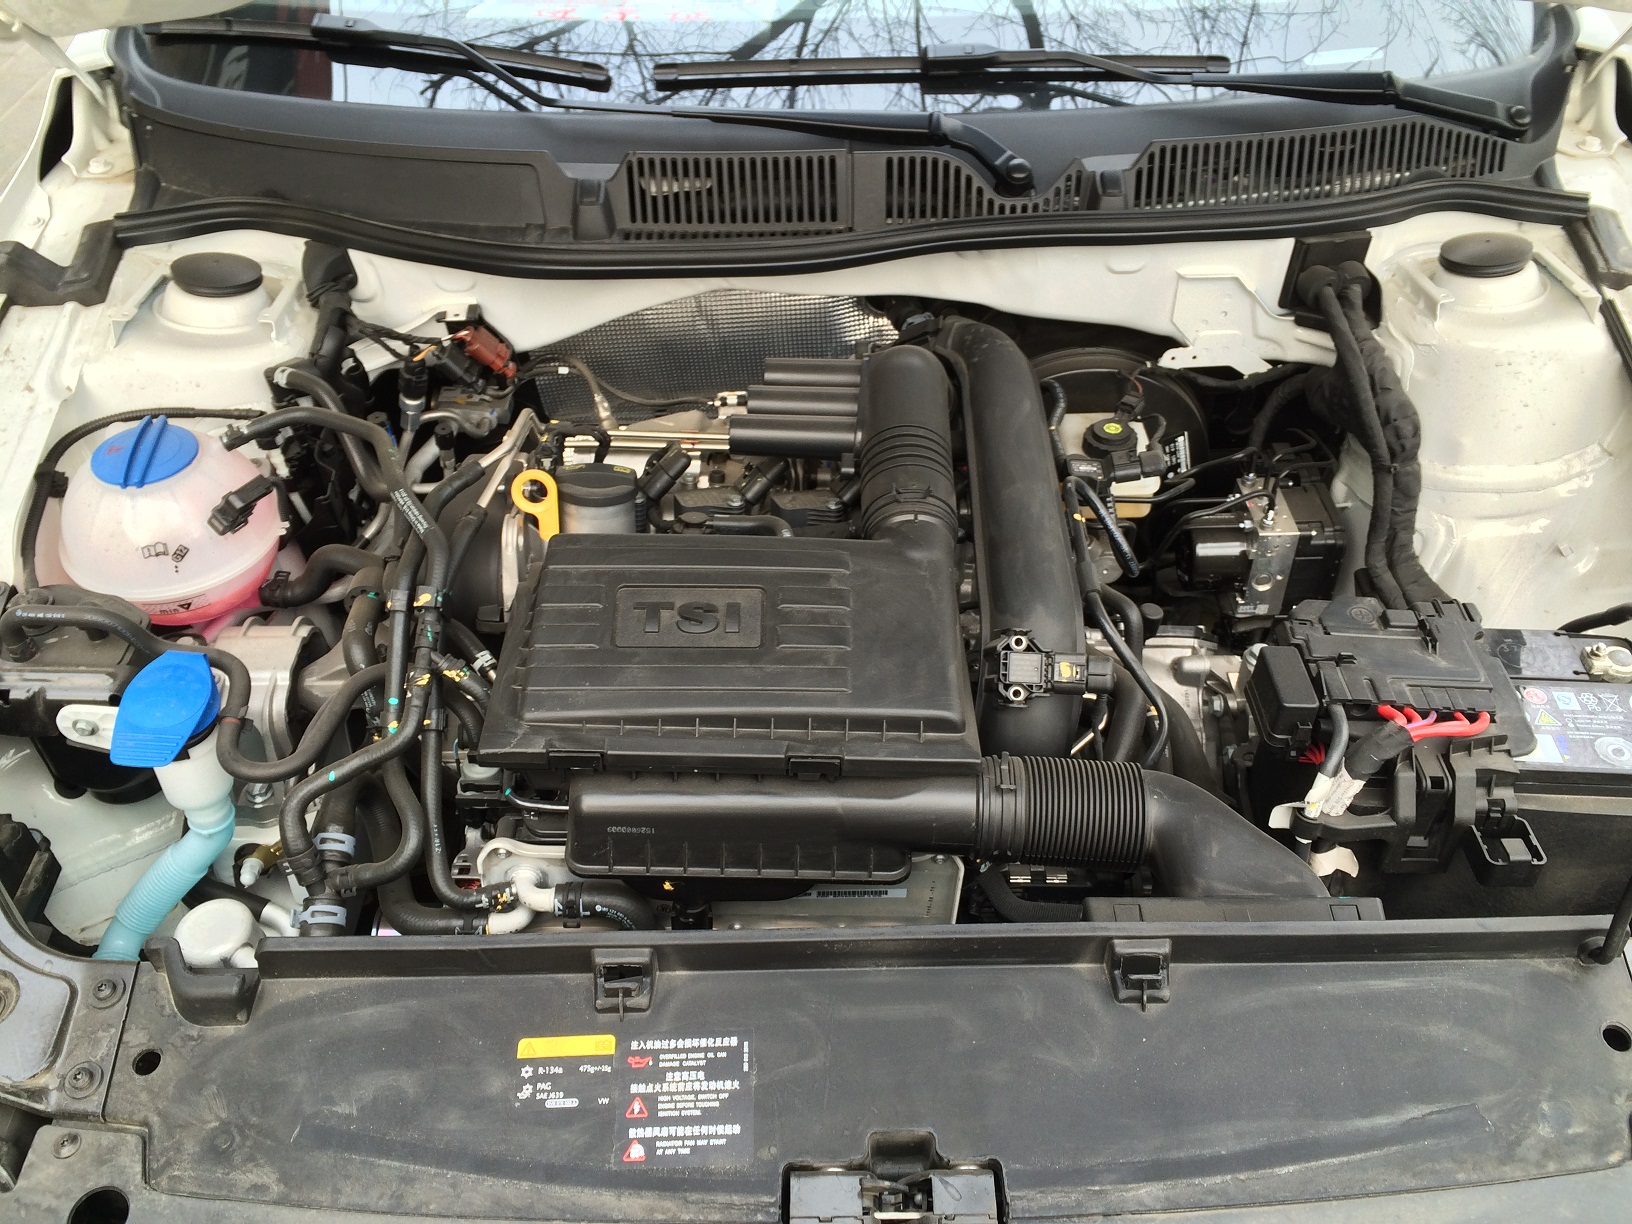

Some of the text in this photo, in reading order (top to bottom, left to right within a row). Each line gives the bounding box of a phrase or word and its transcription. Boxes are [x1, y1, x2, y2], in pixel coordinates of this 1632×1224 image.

[633, 601, 741, 634] TSI
[538, 1066, 563, 1074] R-134a
[536, 1082, 551, 1090] PAG
